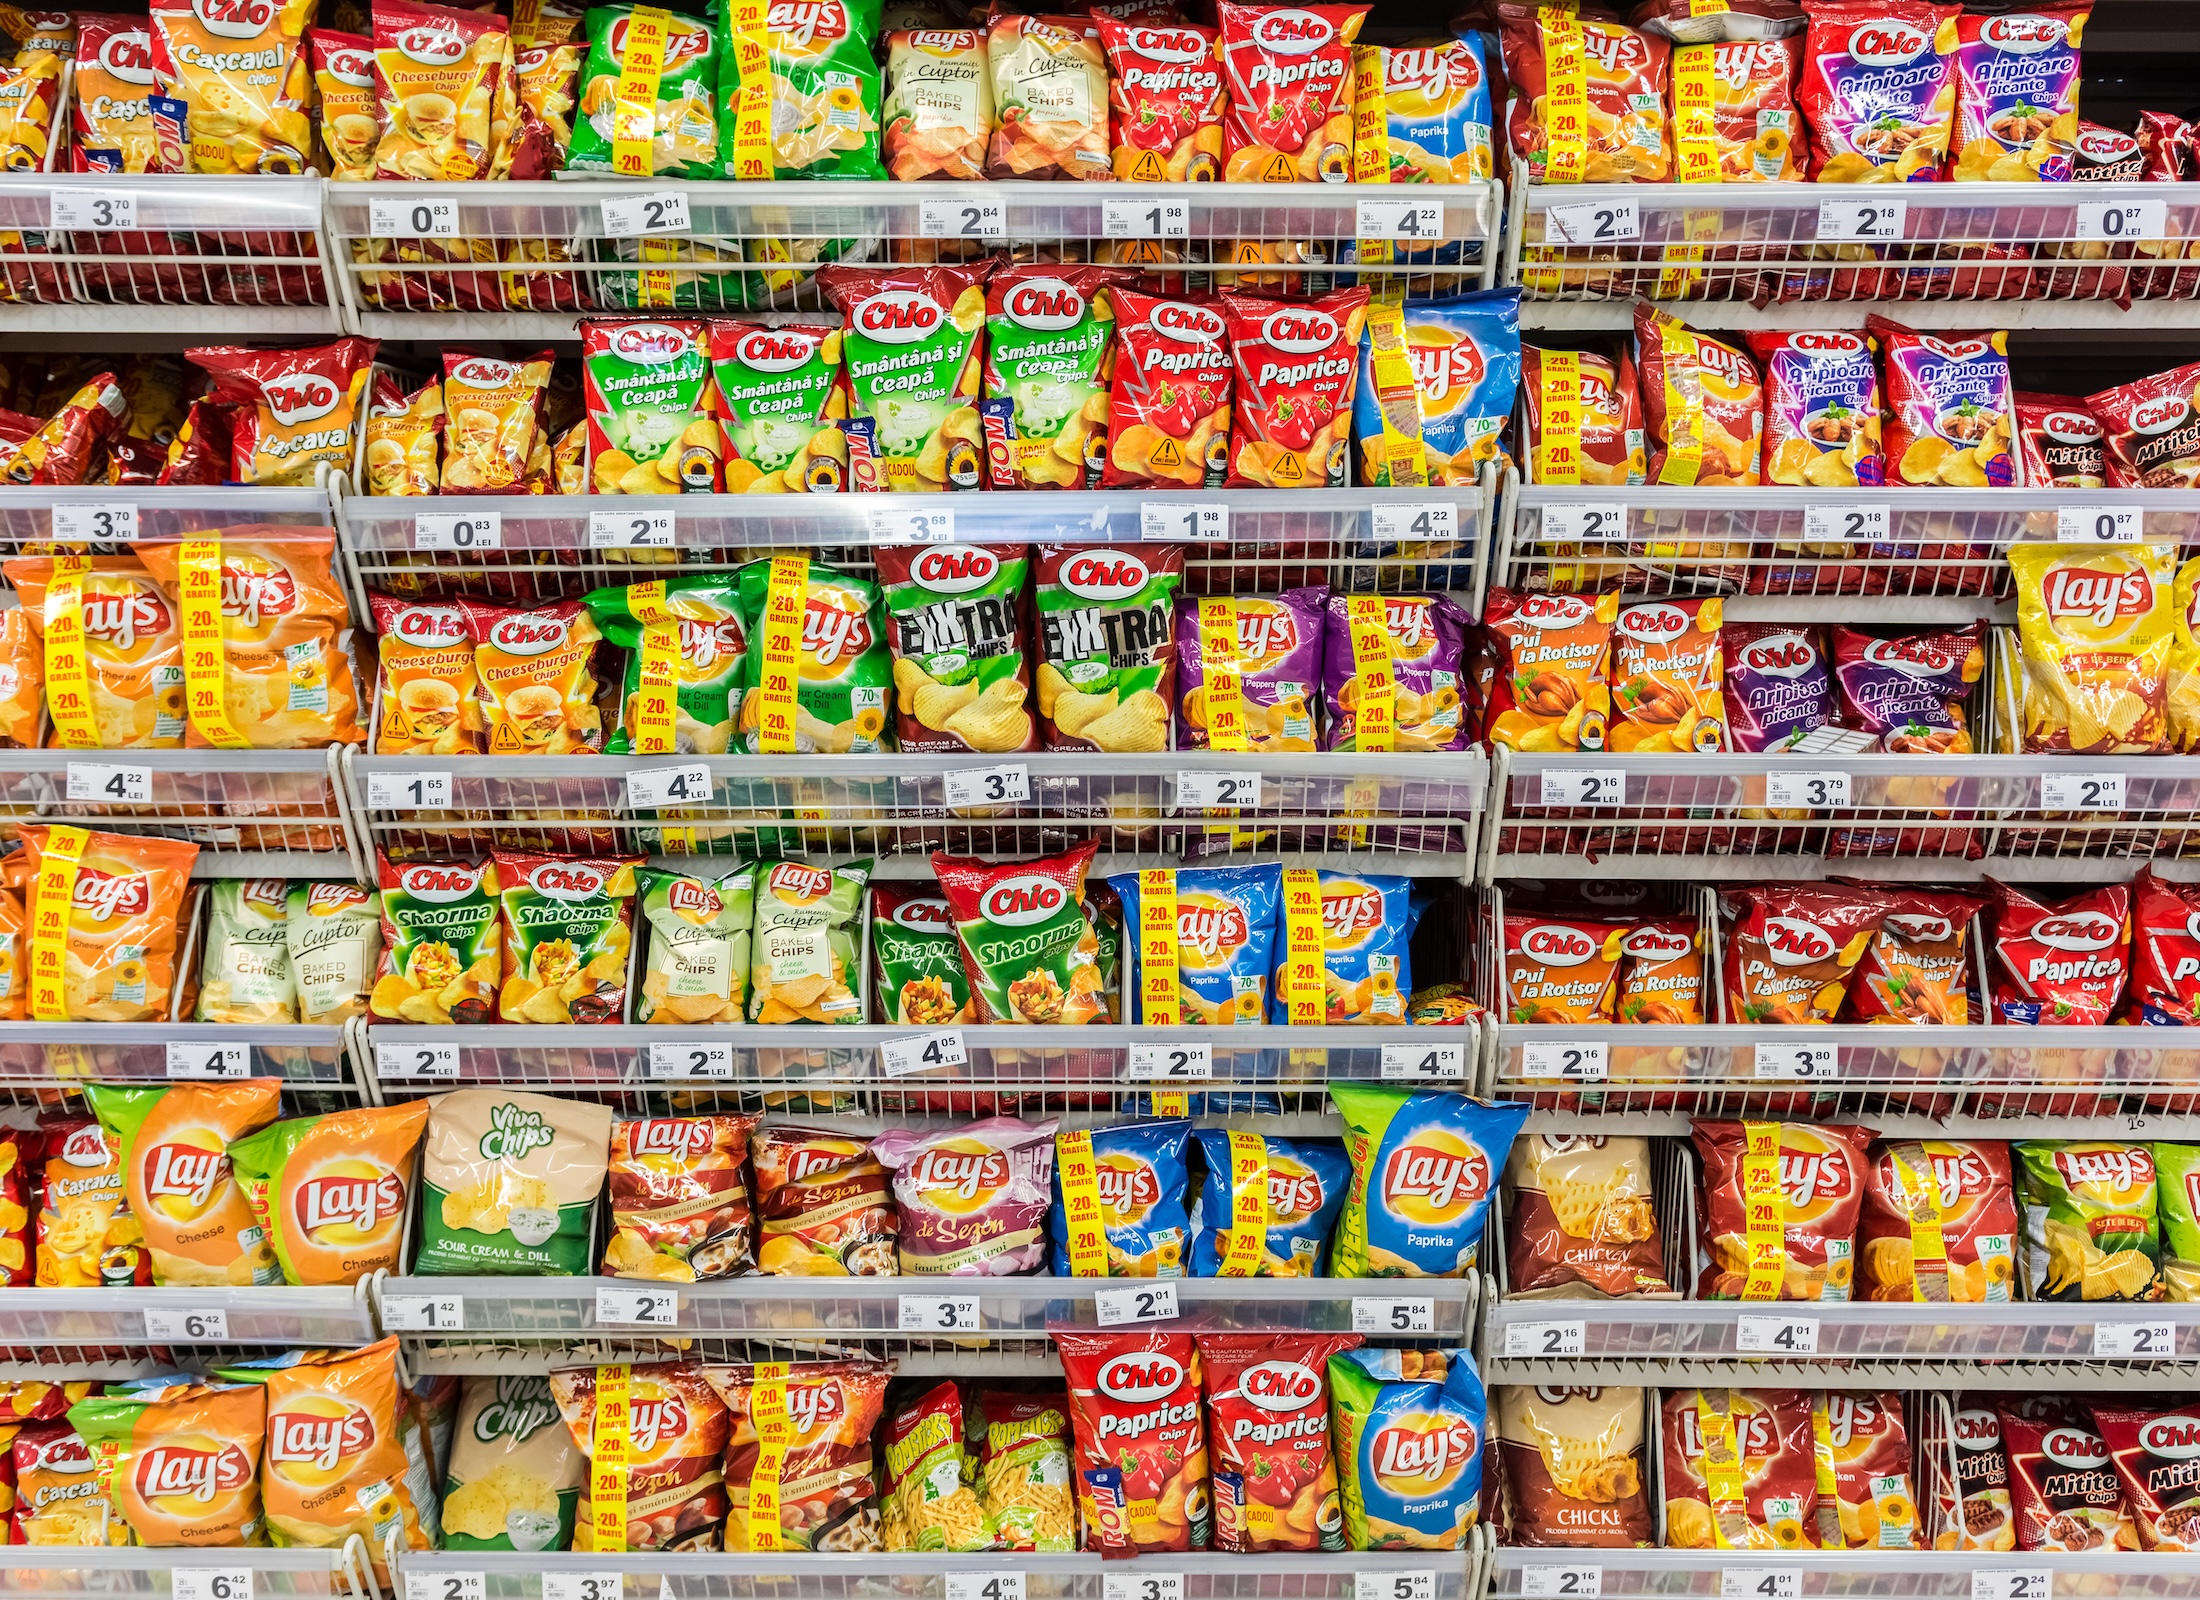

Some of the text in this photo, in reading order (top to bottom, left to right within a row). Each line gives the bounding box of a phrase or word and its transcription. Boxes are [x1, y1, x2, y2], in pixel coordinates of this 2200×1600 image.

[1263, 12, 1328, 44] Chio
[400, 34, 467, 58] Chio
[631, 36, 661, 46] GRATIS
[392, 69, 478, 84] Cheeseburger
[918, 64, 980, 82] Cuptor
[1251, 59, 1345, 90] Paprica
[1678, 63, 1710, 73] GRATIS
[1975, 56, 2073, 81] Aripioare
[247, 73, 277, 85] Chips
[434, 81, 463, 92] Chips
[1306, 82, 1332, 93] Chips
[1988, 80, 2045, 96] picante
[915, 87, 952, 100] BAKED
[2032, 91, 2059, 102] Chips
[915, 97, 961, 111] CHIPS
[921, 114, 954, 125] paprika
[1410, 126, 1449, 138] Paprika
[194, 144, 224, 163] CADOU
[93, 200, 113, 227] 3
[115, 201, 129, 210] 70
[644, 199, 684, 229] 2 01 LEI
[1856, 209, 1878, 235] 2
[1881, 209, 1895, 218] 18
[1398, 210, 1421, 237] 4
[1422, 210, 1436, 219] 22
[862, 296, 936, 330] Chio
[1271, 315, 1330, 344] Chio
[1800, 335, 1857, 352] Chio
[852, 350, 943, 378] Smântână
[1259, 357, 1349, 386] Paprica
[871, 368, 935, 395] Ceapă
[1313, 380, 1339, 392] Chips
[914, 386, 946, 401] Chips
[1545, 393, 1576, 403] GRATIS
[989, 417, 1016, 485] ROM
[889, 463, 915, 478] CADOU
[2079, 462, 2103, 472] Chips
[630, 520, 651, 545] 2
[653, 520, 667, 528] 16
[1844, 514, 1865, 539] 2
[1868, 513, 1881, 522] 18
[2052, 569, 2144, 626] Lay's
[264, 606, 280, 614] Chips
[1519, 598, 1583, 620] Chio
[2123, 605, 2137, 613] Chips
[188, 628, 219, 638] GRATIS
[1511, 631, 1541, 650] Pui
[230, 651, 269, 661] Cheese
[765, 654, 795, 664] GRATIS
[969, 641, 1008, 660] CHIPS
[1519, 642, 1601, 663] la Rotisor
[431, 664, 463, 676] Chips
[1400, 667, 1430, 679] Peppers
[1566, 658, 1591, 669] Chips
[806, 700, 830, 710] & Dill
[816, 691, 846, 701] Cream
[1759, 701, 1818, 728] picante
[985, 773, 1023, 800] 3 77 LEI
[1581, 778, 1601, 803] 2
[1604, 778, 1617, 787] 16
[772, 864, 831, 896] Lay's
[398, 903, 491, 927] Shaorma
[1144, 920, 1173, 930] GRATIS
[2040, 914, 2111, 943] Chio
[771, 936, 813, 949] BAKED
[979, 917, 1085, 966] Shaorma
[771, 945, 813, 958] CHIPS
[302, 961, 346, 974] BAKED
[778, 957, 808, 970] cheese
[788, 965, 808, 976] onion
[2028, 955, 2121, 983] Paprica
[303, 972, 346, 984] CHIPS
[1190, 975, 1219, 986] Paprika
[206, 1052, 227, 1075] 4
[228, 1052, 240, 1060] 51
[1795, 1052, 1815, 1076] 3
[1816, 1052, 1830, 1060] 80
[493, 1104, 542, 1135] Viva
[481, 1121, 554, 1158] Chips
[635, 1119, 711, 1160] Lay's
[1390, 1150, 1485, 1208] Lay's
[307, 1177, 398, 1232] Lay's
[916, 1221, 935, 1238] de
[437, 1239, 551, 1262] SOUR CREAM & DILL
[1407, 1233, 1453, 1249] Paprika
[343, 1254, 390, 1273] Cheese
[186, 1316, 206, 1338] 6
[206, 1316, 219, 1324] 42
[1391, 1306, 1411, 1330] 5
[1412, 1306, 1426, 1314] 84
[2133, 1329, 2153, 1353] 2
[2154, 1328, 2168, 1337] 20
[1108, 1362, 1176, 1388] Chio
[1100, 1402, 1196, 1438] Paprica
[1017, 1441, 1066, 1459] Sour Cream
[1103, 1486, 1126, 1547] ROM
[1130, 1504, 1157, 1518] CADOU
[181, 1522, 230, 1539] Cheese
[1757, 1576, 1778, 1597] 4
